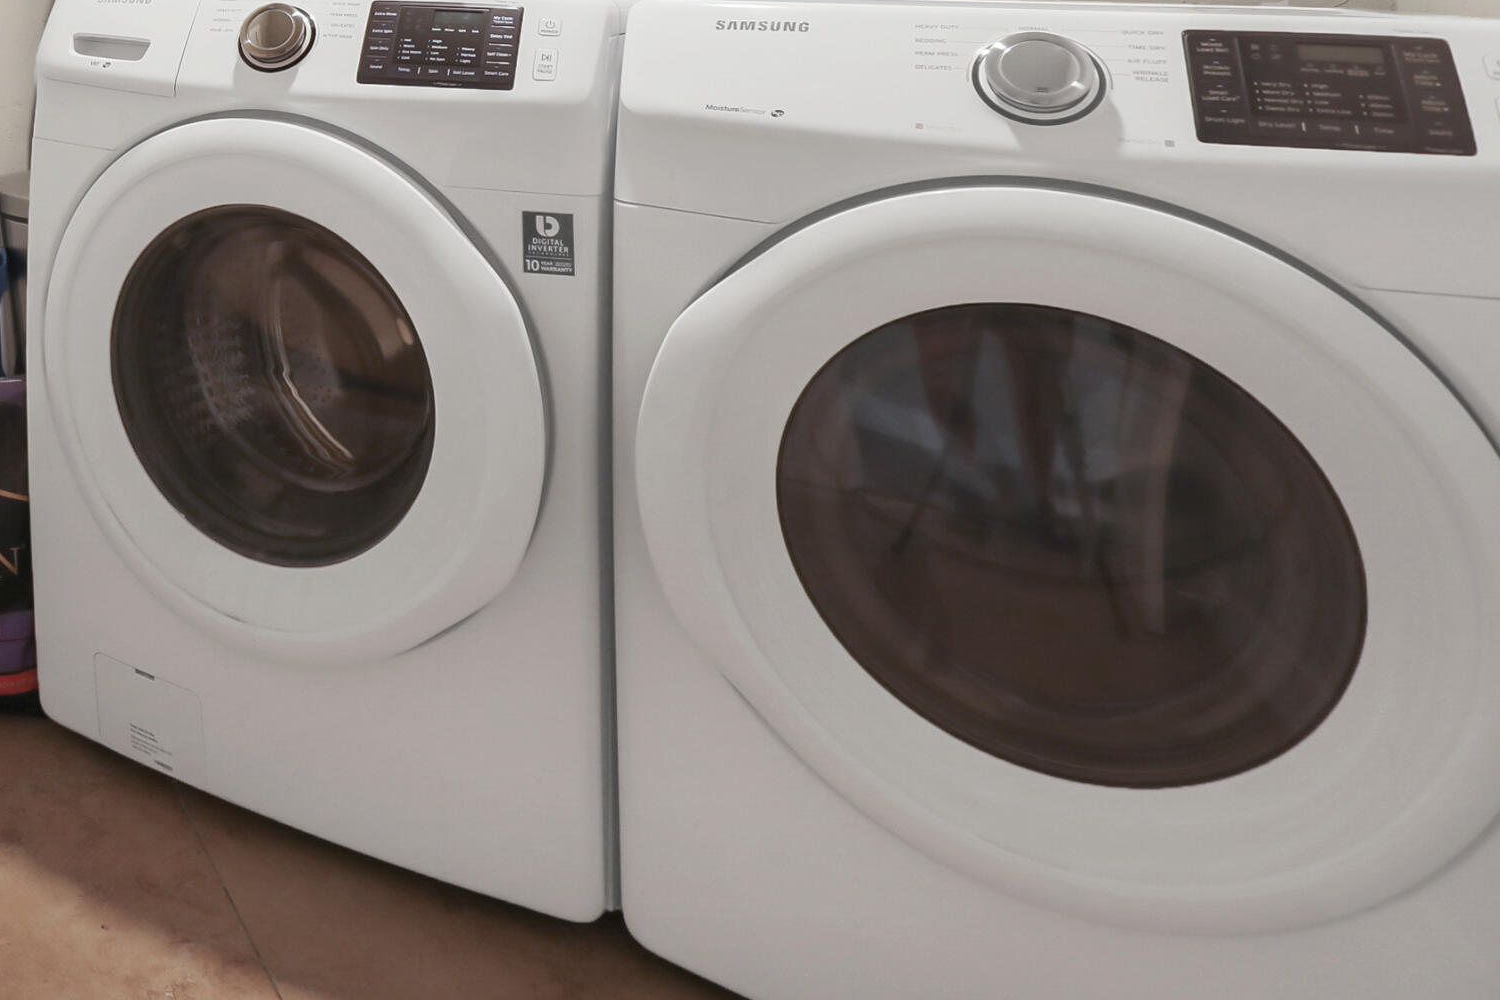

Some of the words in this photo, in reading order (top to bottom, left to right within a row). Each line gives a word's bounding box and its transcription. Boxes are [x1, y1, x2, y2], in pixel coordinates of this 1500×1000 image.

[715, 19, 810, 33] SAMSUNG
[532, 237, 565, 247] DIGITAL
[527, 243, 570, 254] INVERTER
[525, 259, 540, 272] 10
[540, 265, 573, 273] WARRANTY
